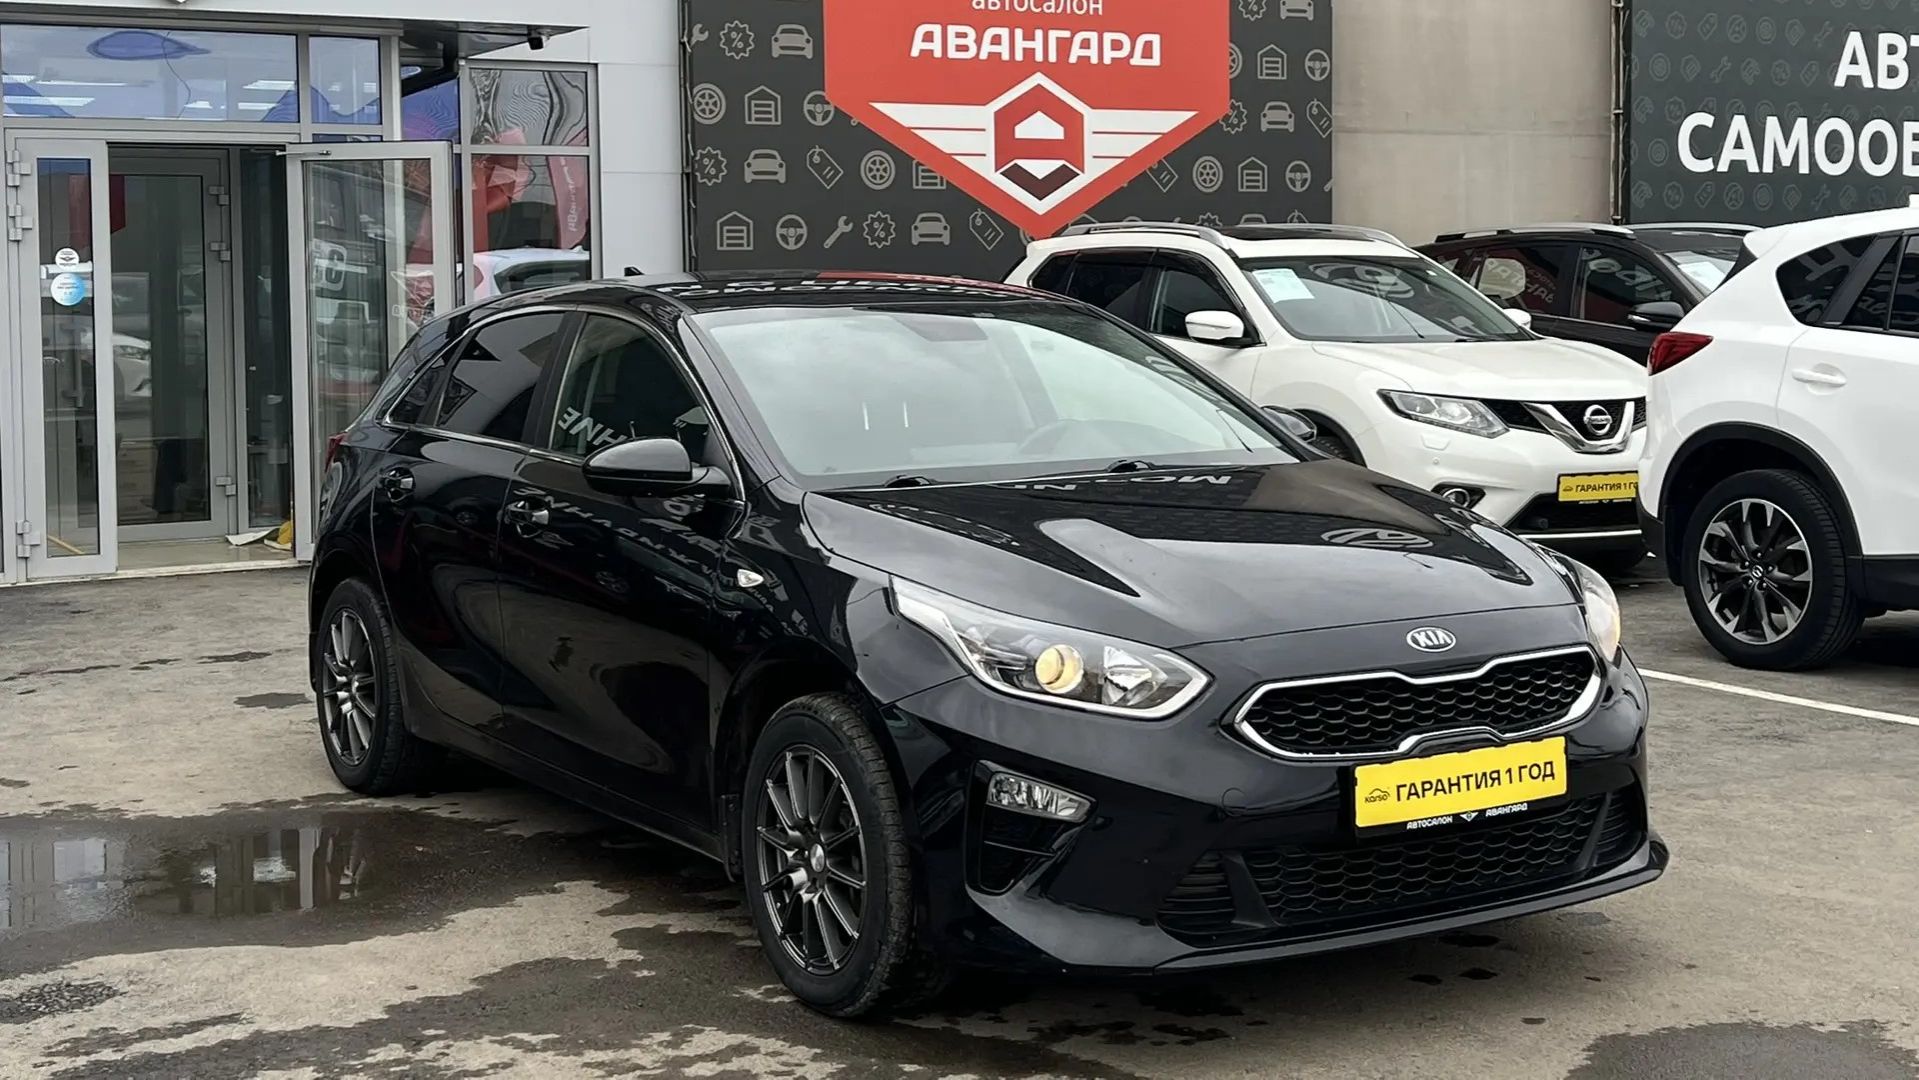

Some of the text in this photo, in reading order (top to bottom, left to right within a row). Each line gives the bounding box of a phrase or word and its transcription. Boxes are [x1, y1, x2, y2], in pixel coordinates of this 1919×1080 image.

[910, 23, 1161, 66] АВАНГАРД
[1575, 482, 1622, 493] ГАРАНТИЯ
[1412, 629, 1453, 648] KIA
[1396, 761, 1555, 802] ГАРАНТИЯ 1 ГОД
[1406, 802, 1528, 830] АВТОСАЛОН АВАНГАРД
